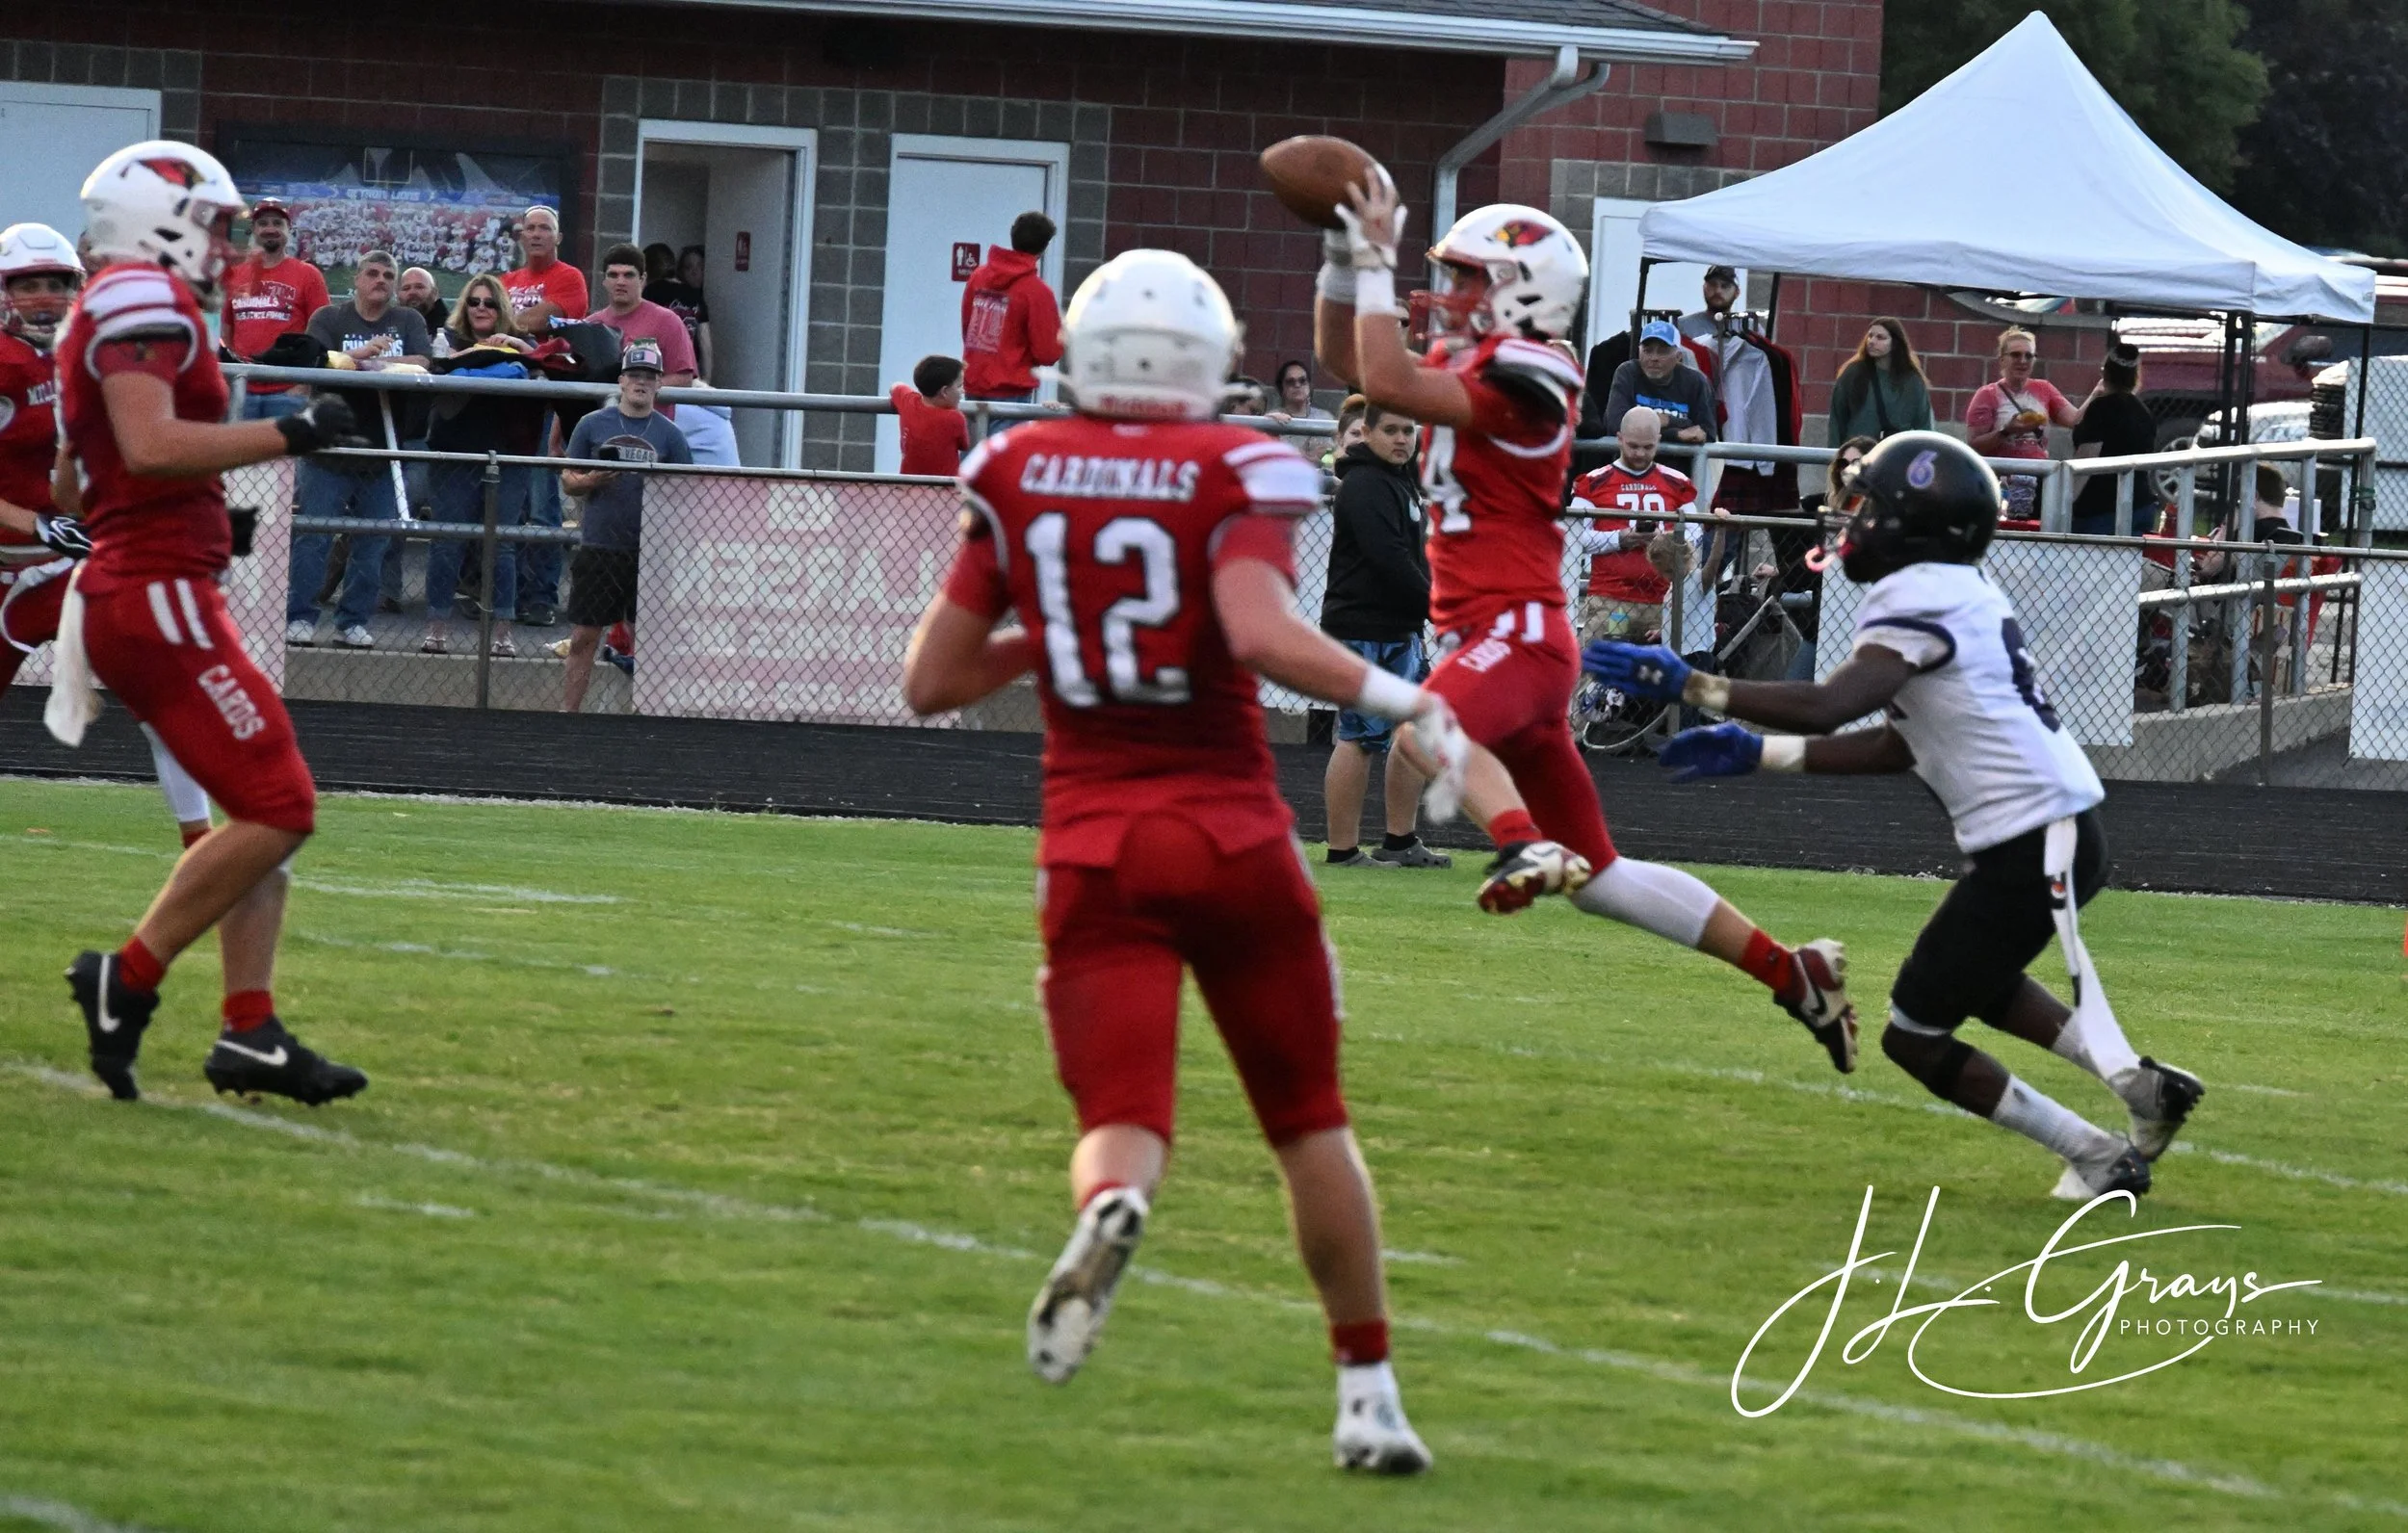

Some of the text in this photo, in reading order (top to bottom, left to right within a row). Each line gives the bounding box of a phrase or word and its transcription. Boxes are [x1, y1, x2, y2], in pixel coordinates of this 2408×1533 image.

[1019, 453, 1202, 503] CARDINALS
[1907, 449, 1939, 489] 6
[1025, 511, 1192, 709] 12
[196, 663, 266, 741] CARDS
